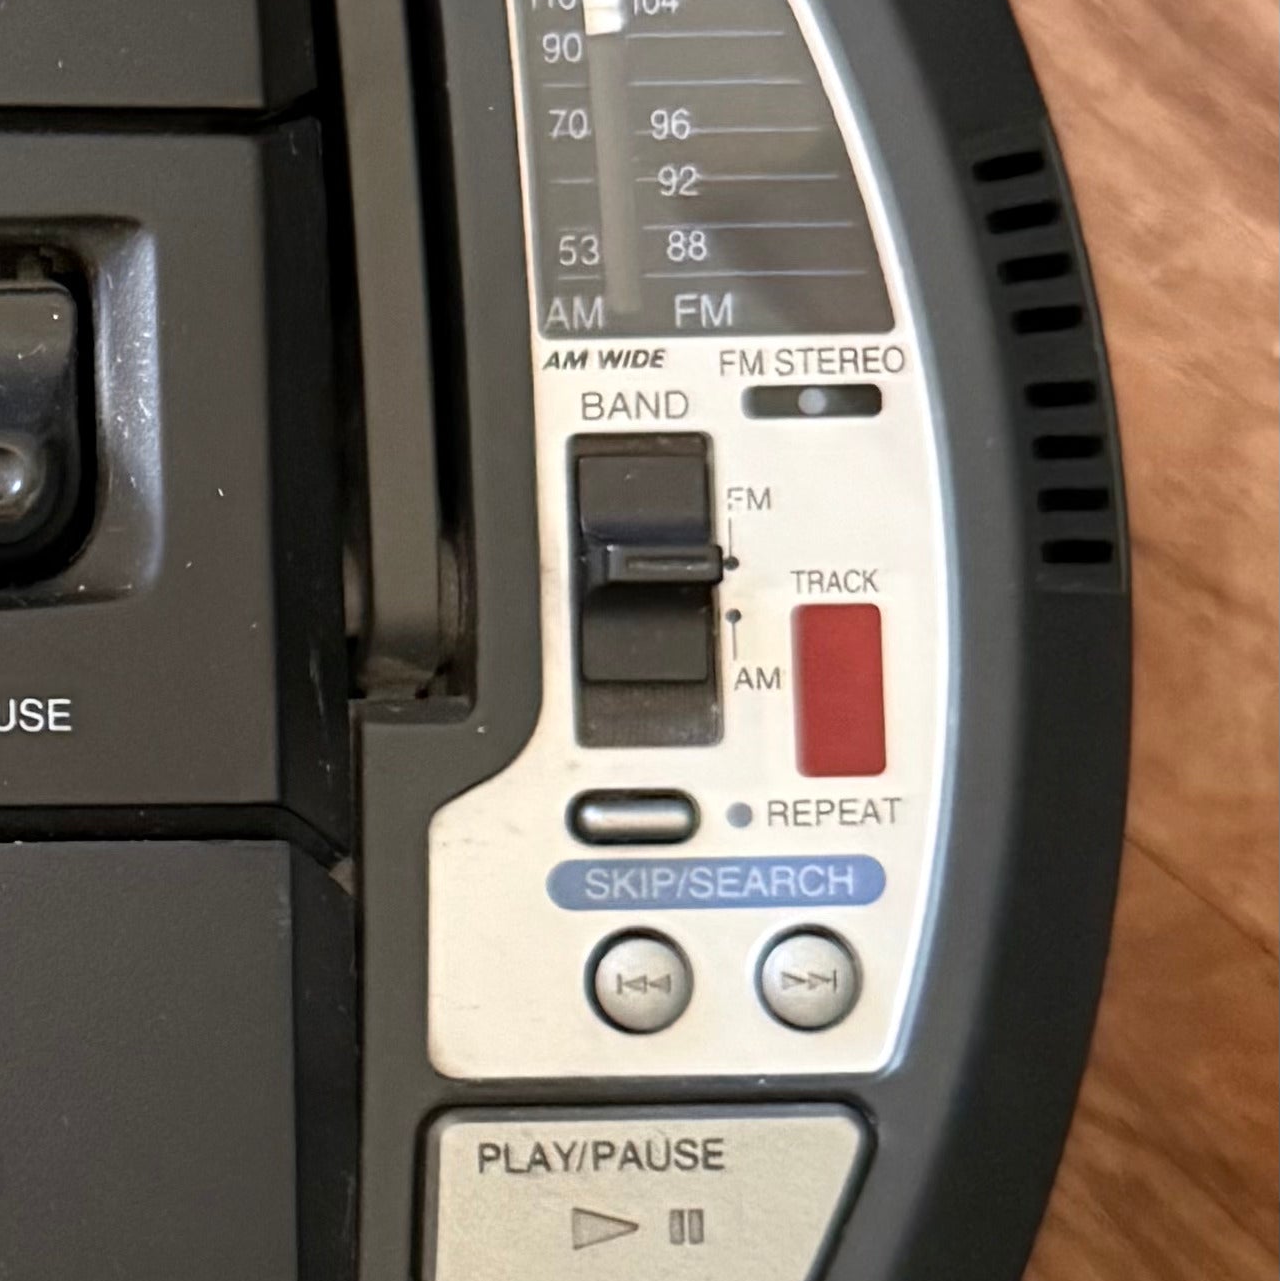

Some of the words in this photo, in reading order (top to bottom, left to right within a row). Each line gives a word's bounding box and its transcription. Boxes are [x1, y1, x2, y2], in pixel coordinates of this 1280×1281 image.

[542, 33, 582, 64] 90
[550, 109, 588, 140] 70
[650, 108, 691, 140] 96
[658, 165, 700, 197] 92
[558, 235, 600, 266] 53
[666, 231, 707, 262] 88
[545, 296, 603, 329] AM
[674, 293, 733, 328] FM
[543, 350, 588, 370] AM
[598, 349, 667, 369] WIDE
[720, 349, 765, 376] FM
[774, 345, 906, 375] STEREO
[580, 391, 689, 420] BAND
[727, 487, 772, 511] FM
[791, 569, 879, 594] TRACK
[733, 667, 781, 691] AM
[766, 797, 903, 828] REPEAT
[583, 865, 855, 901] SKIP/SEARCH
[477, 1137, 725, 1174] PLAY/PAUSE
